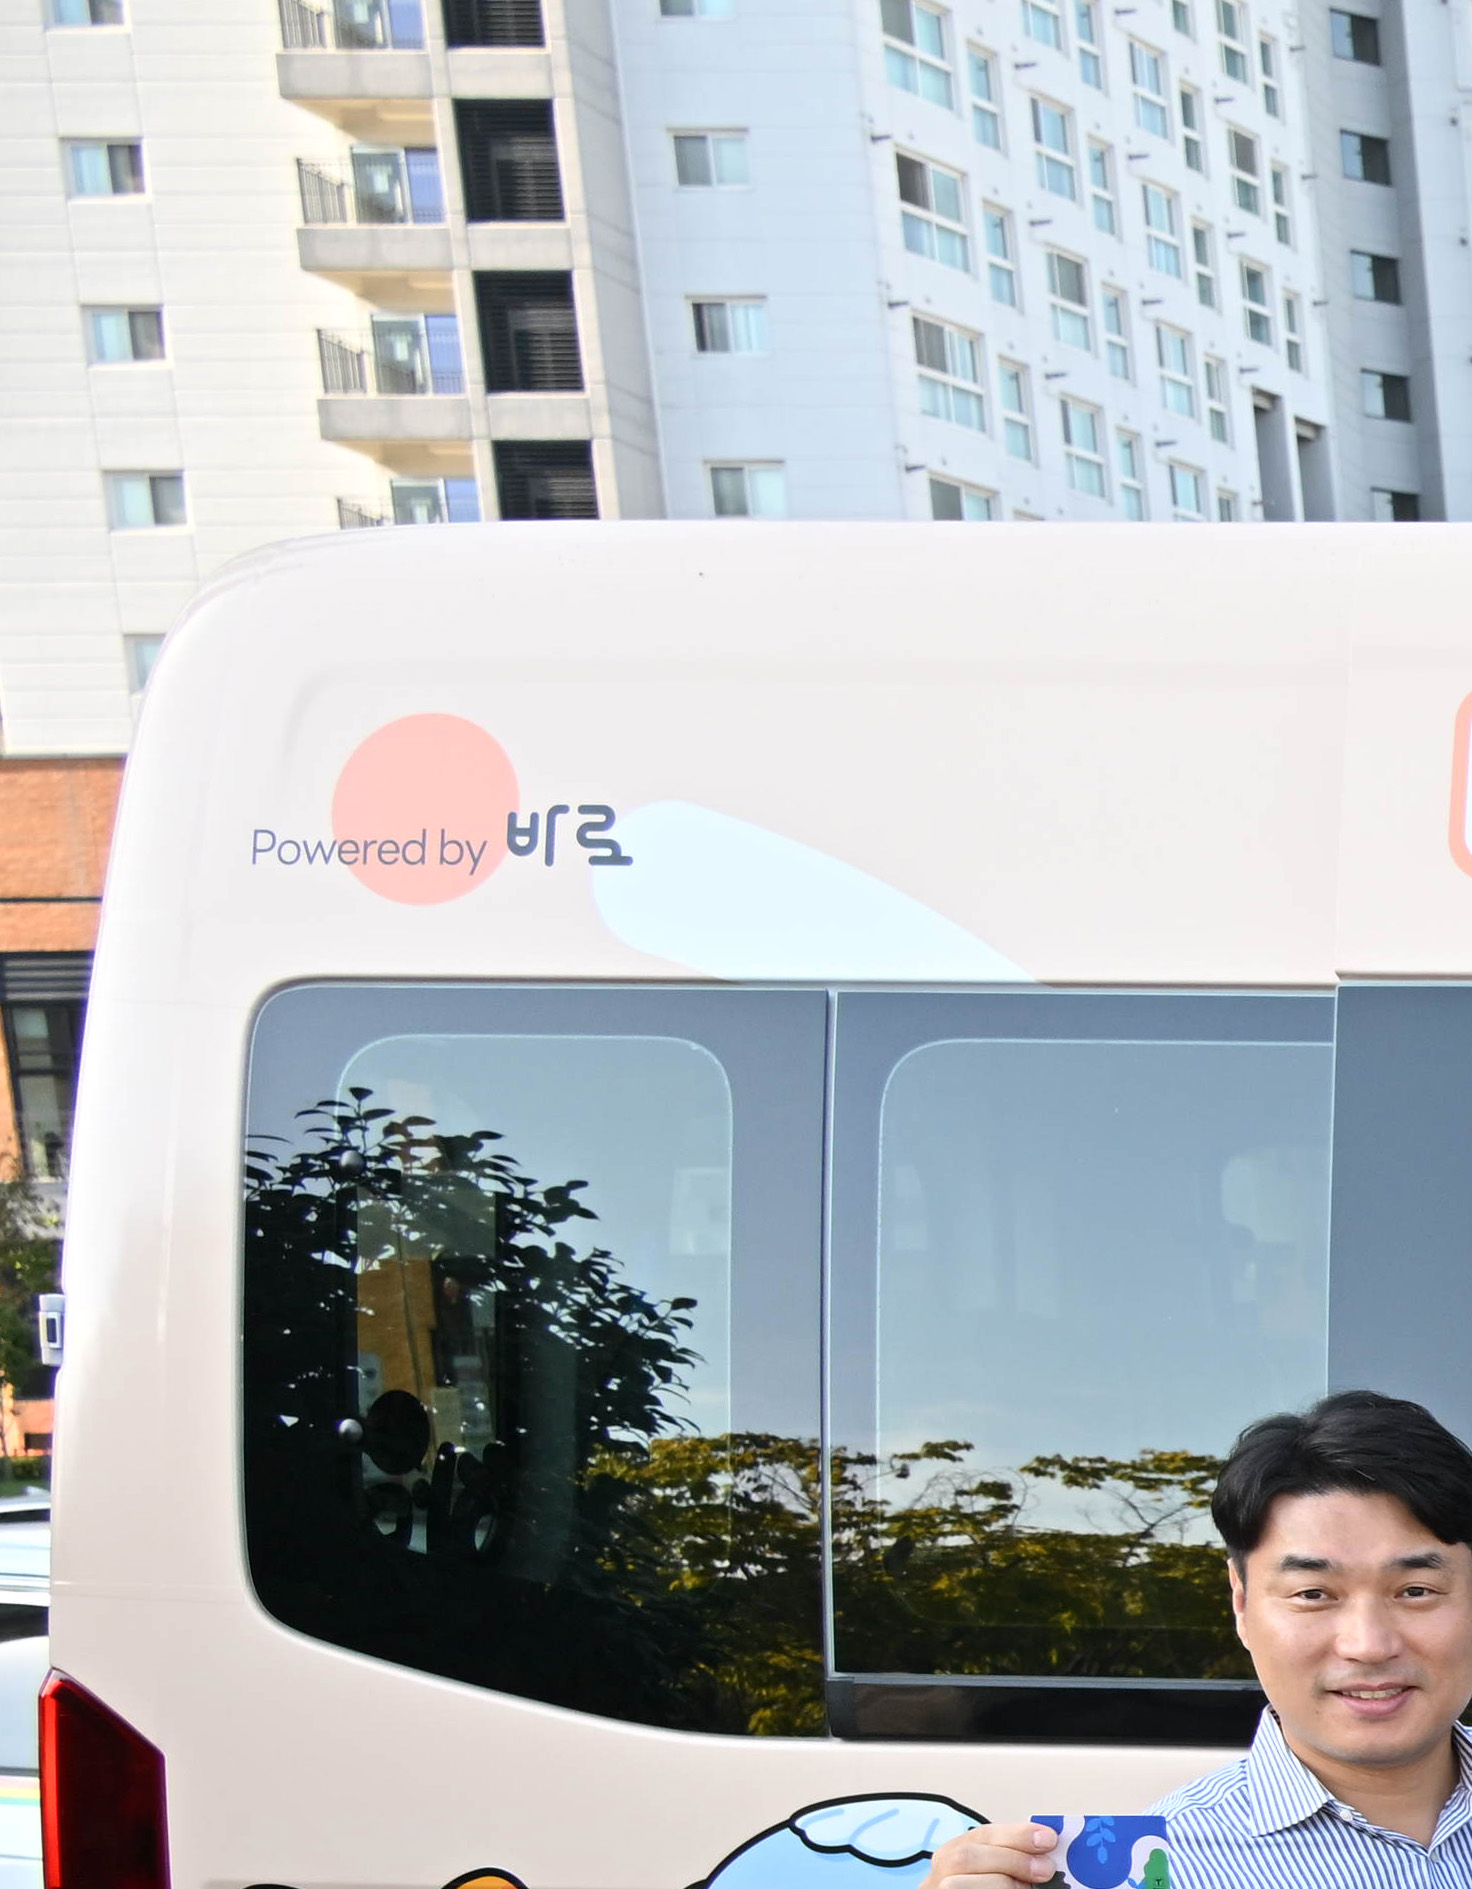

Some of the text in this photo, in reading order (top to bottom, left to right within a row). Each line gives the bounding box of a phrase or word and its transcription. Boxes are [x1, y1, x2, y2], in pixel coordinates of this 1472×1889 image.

[252, 804, 633, 874] Powered by 바로
